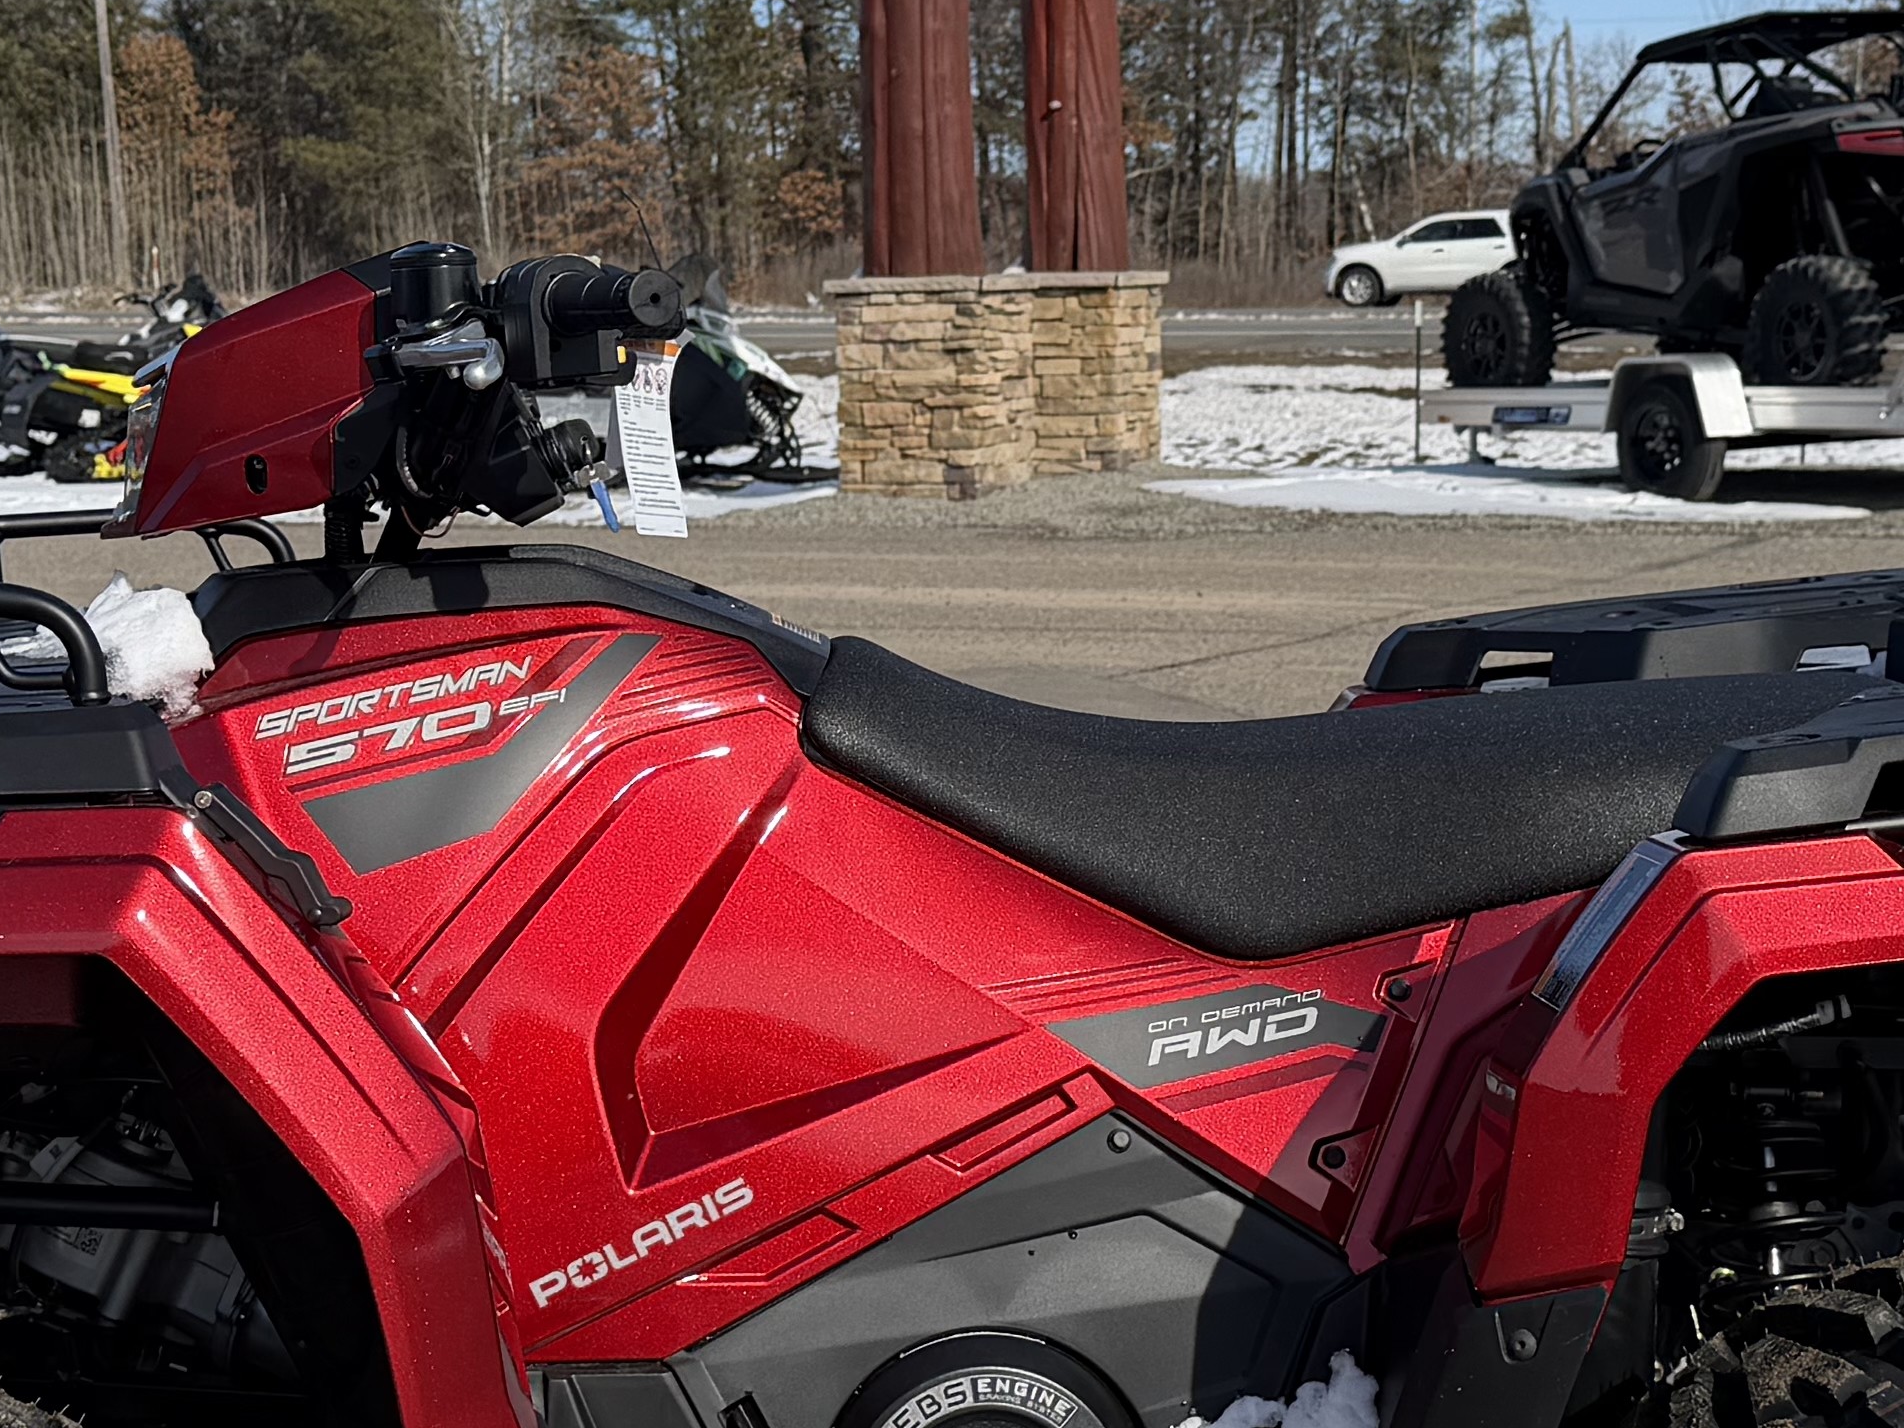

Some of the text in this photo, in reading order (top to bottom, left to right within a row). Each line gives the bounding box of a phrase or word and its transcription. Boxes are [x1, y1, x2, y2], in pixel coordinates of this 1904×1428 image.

[256, 656, 533, 740] SPORTSMAN
[283, 688, 567, 775] 570 EFI
[1148, 1007, 1318, 1066] AWD
[528, 1177, 754, 1308] POLARIS
[977, 1378, 1072, 1417] ENGINE
